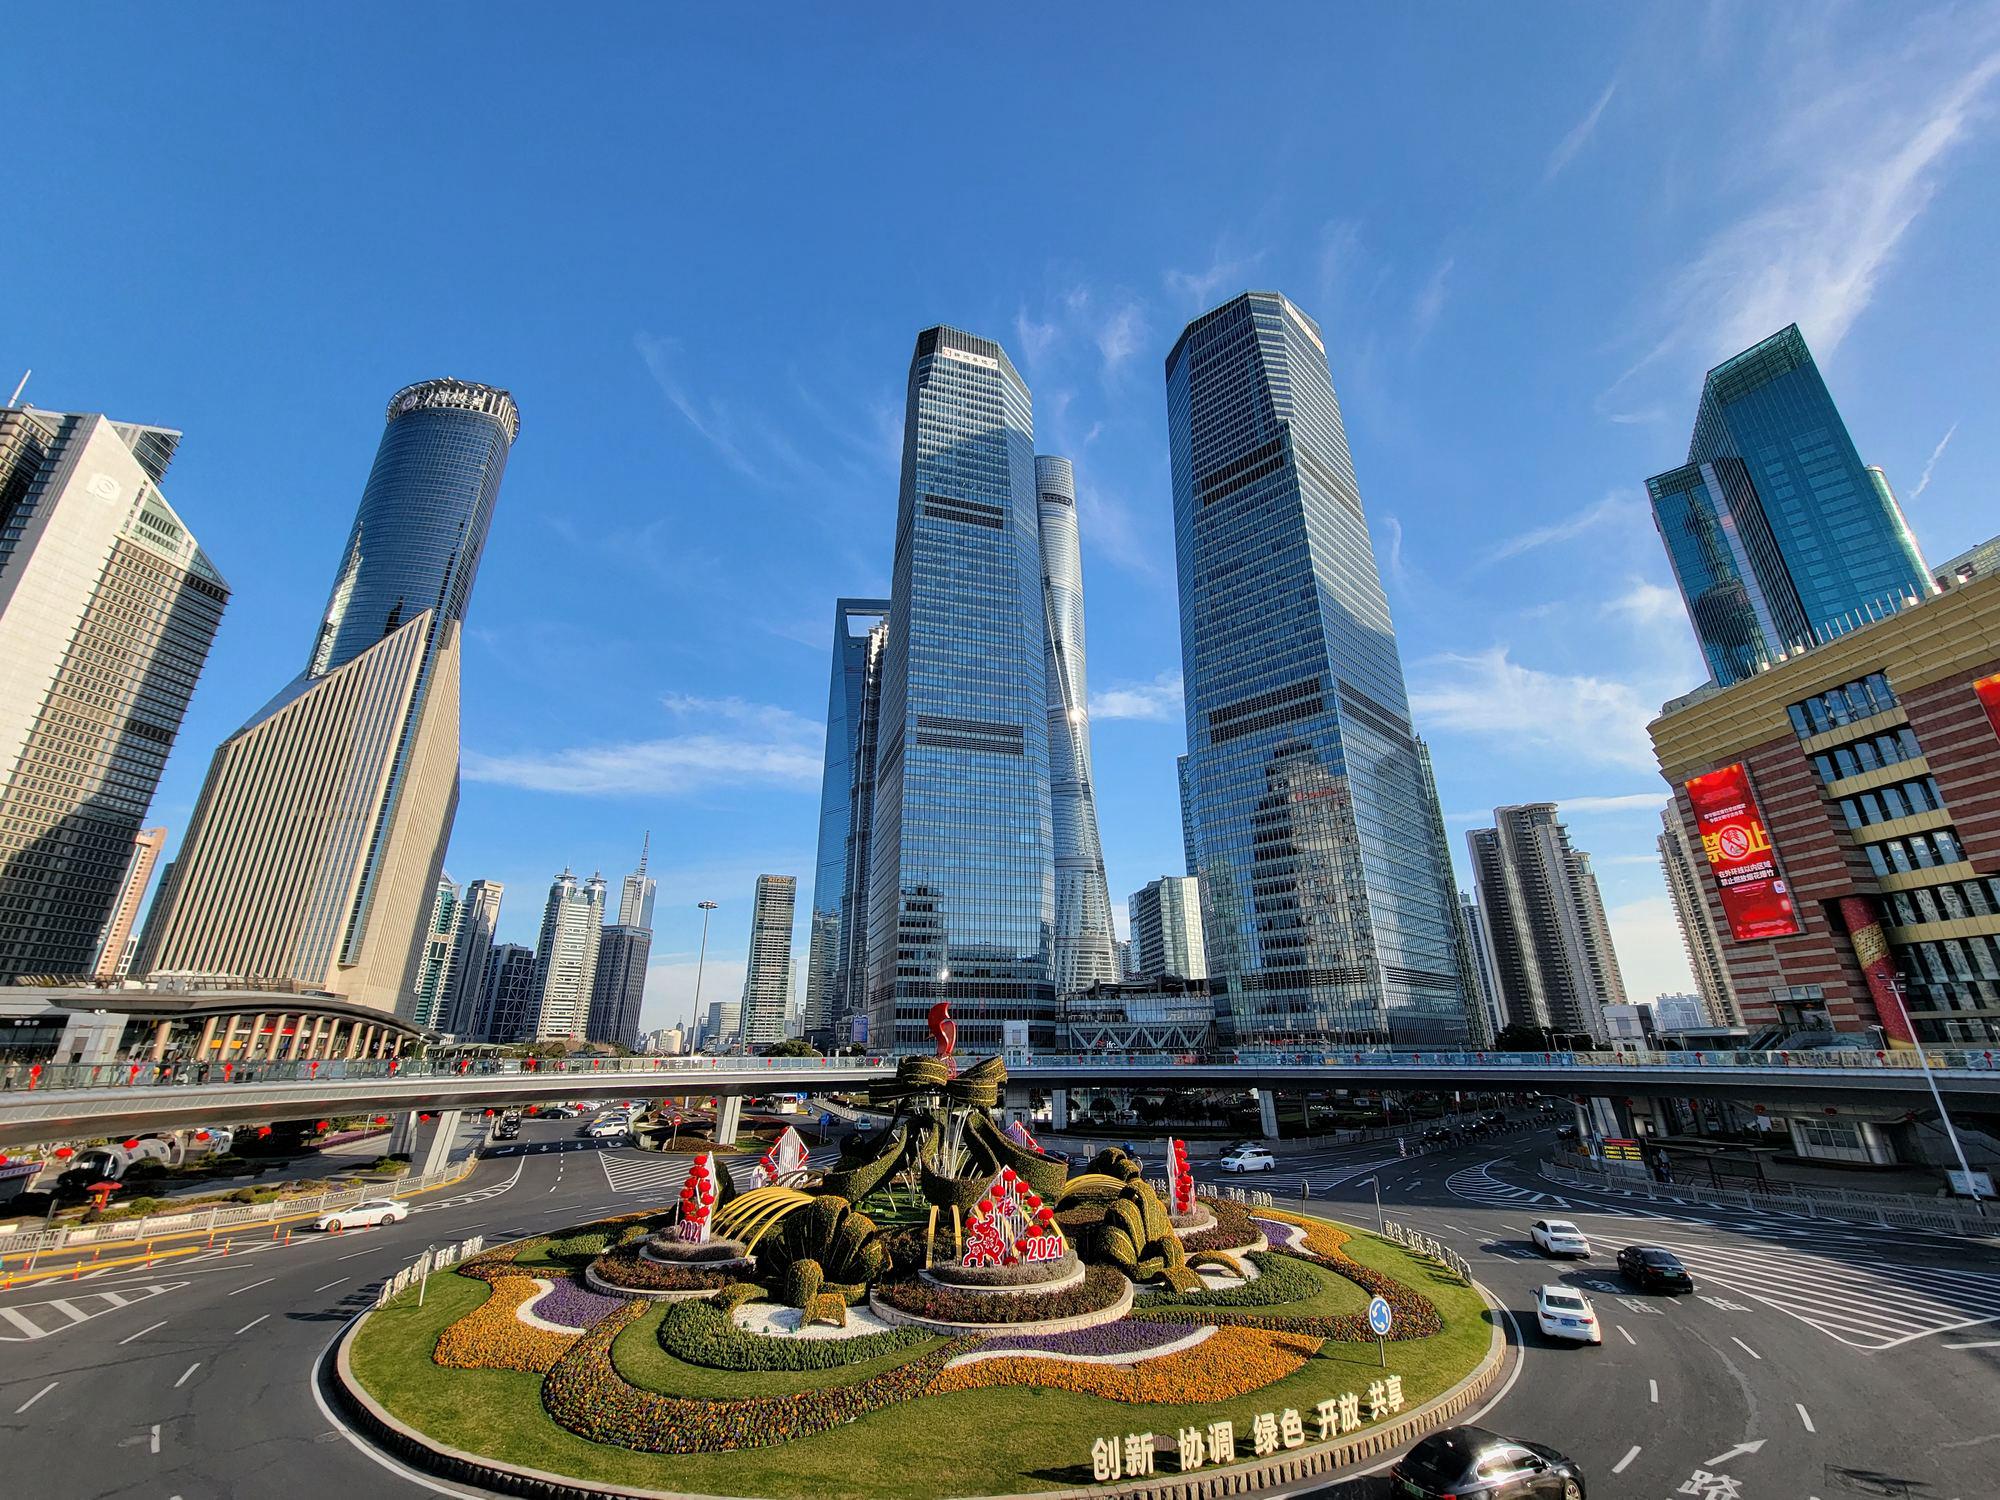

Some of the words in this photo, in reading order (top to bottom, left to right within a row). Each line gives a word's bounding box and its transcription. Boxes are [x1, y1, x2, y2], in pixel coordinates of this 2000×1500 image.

[679, 1219, 703, 1244] 2021
[1026, 1235, 1064, 1262] 2021
[1091, 1431, 1154, 1481] 创新
[1177, 1420, 1235, 1471] 协调
[1252, 1408, 1305, 1456] 绿色
[1315, 1391, 1362, 1441] 开放
[1368, 1374, 1406, 1422] 共享
